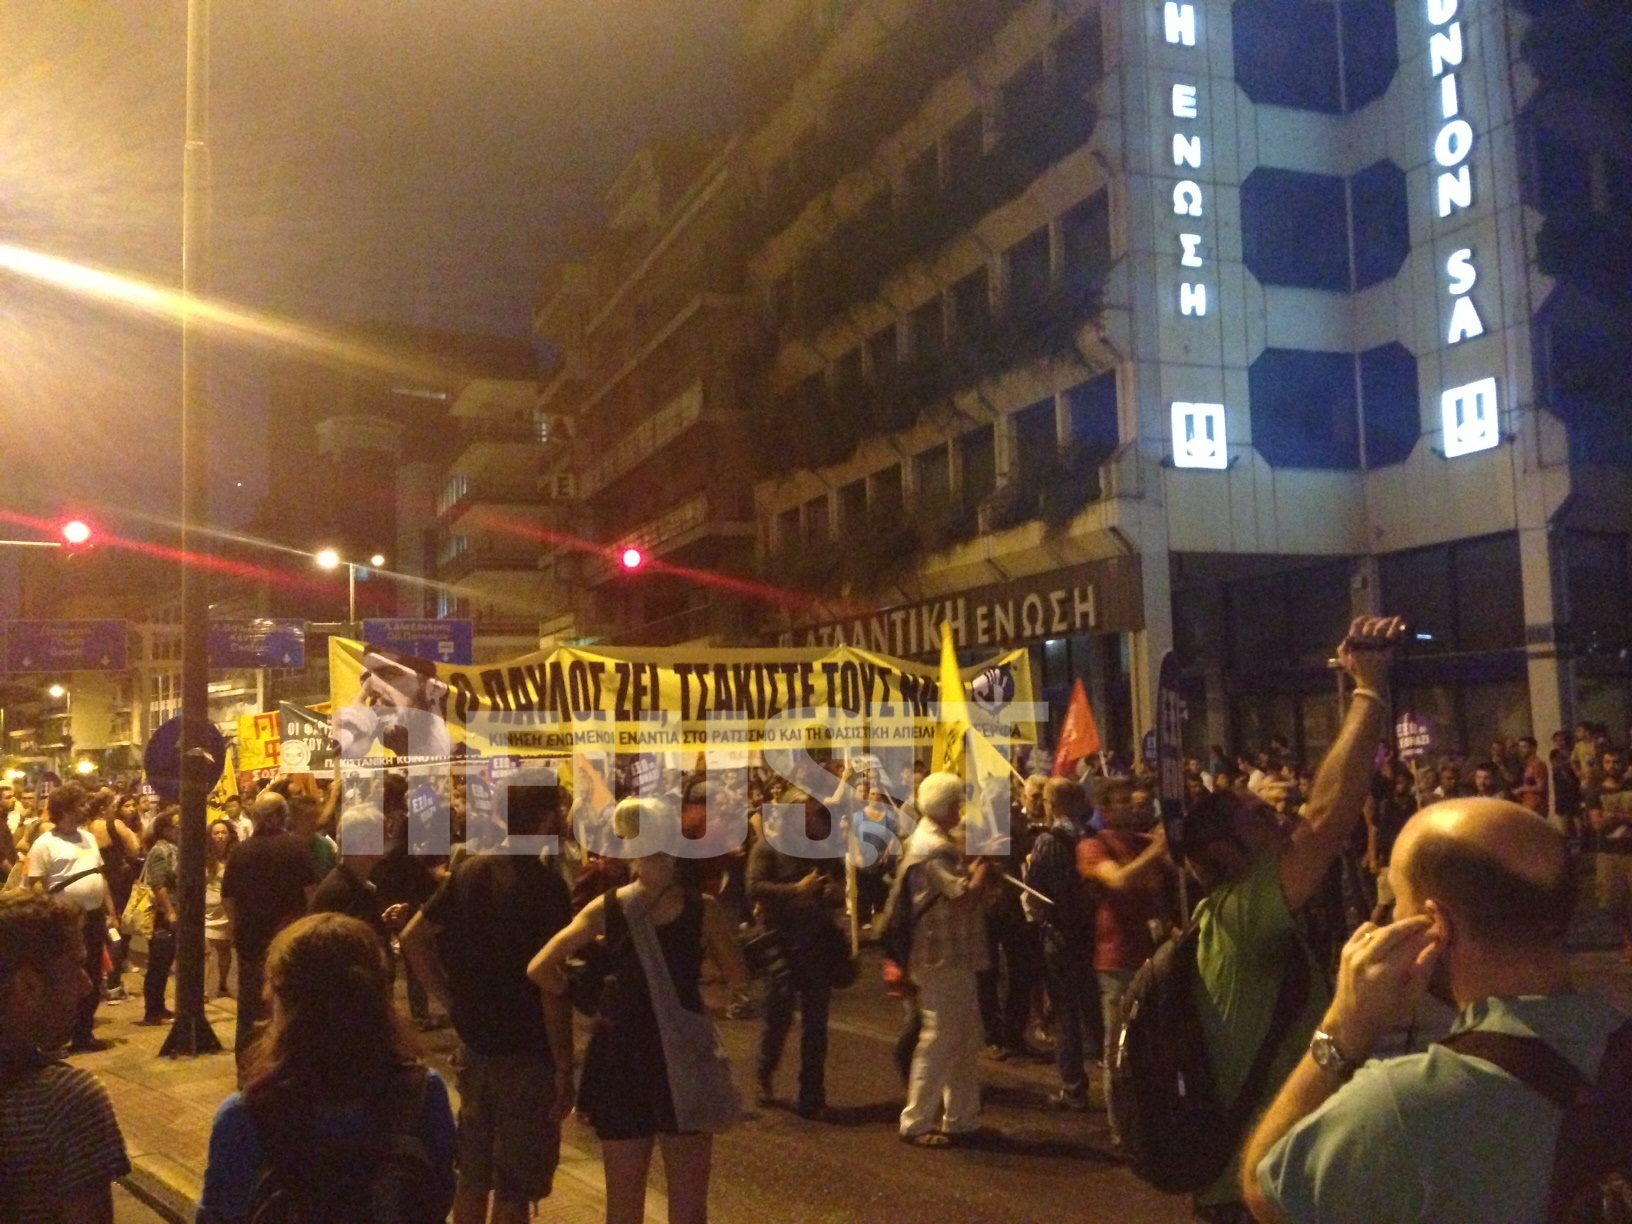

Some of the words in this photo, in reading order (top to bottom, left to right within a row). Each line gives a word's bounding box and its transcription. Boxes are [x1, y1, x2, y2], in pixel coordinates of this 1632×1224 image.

[1172, 84, 1206, 317] ΕΝΩΣΗ
[1447, 248, 1484, 344] SA
[977, 585, 1096, 645] ΕΝΩΣΗ
[480, 660, 606, 727] ΠΑΥΛΟΣ
[673, 661, 818, 722] ΤΣΑΚΙΣΤΕ
[821, 660, 895, 720] ΤΟΥΣ
[325, 757, 393, 768] ΠΚΙΣΤΑΝΙΚΗ
[547, 731, 615, 748] ΕΝΩΜΕΝΟΙ
[619, 730, 680, 746] ΕΝΑΝΤΙΑ
[682, 730, 708, 745] ΣΤΟ
[711, 728, 776, 744] ΡΑΤΣΙΣΜΟ
[780, 727, 802, 742] ΚΑΙ
[805, 727, 822, 741] ΤΗ
[824, 725, 889, 741] ΦΑΣΙΣΤΙΚΗ
